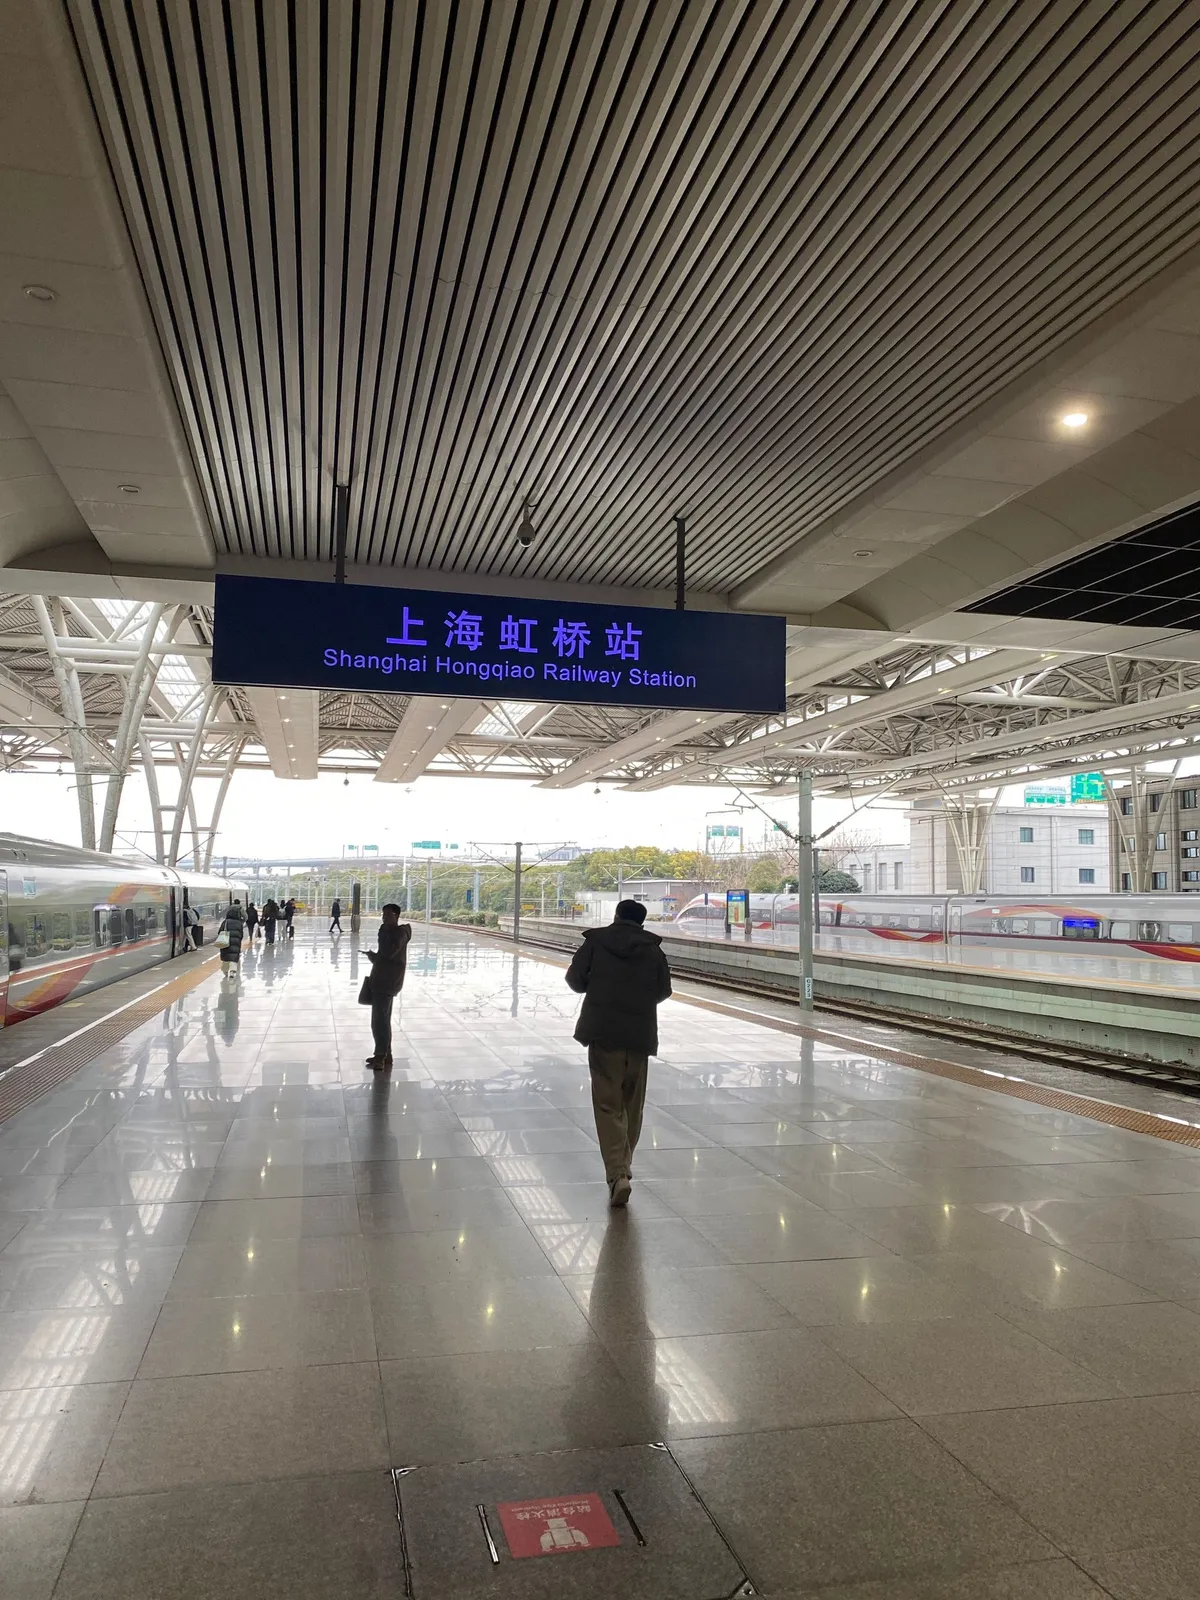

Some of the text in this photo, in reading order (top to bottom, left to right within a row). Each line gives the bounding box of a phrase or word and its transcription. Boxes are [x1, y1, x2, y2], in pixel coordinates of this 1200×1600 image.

[386, 606, 643, 661] 上海虹桥站
[323, 648, 697, 688] Shanghai Hongqiao Railway Station
